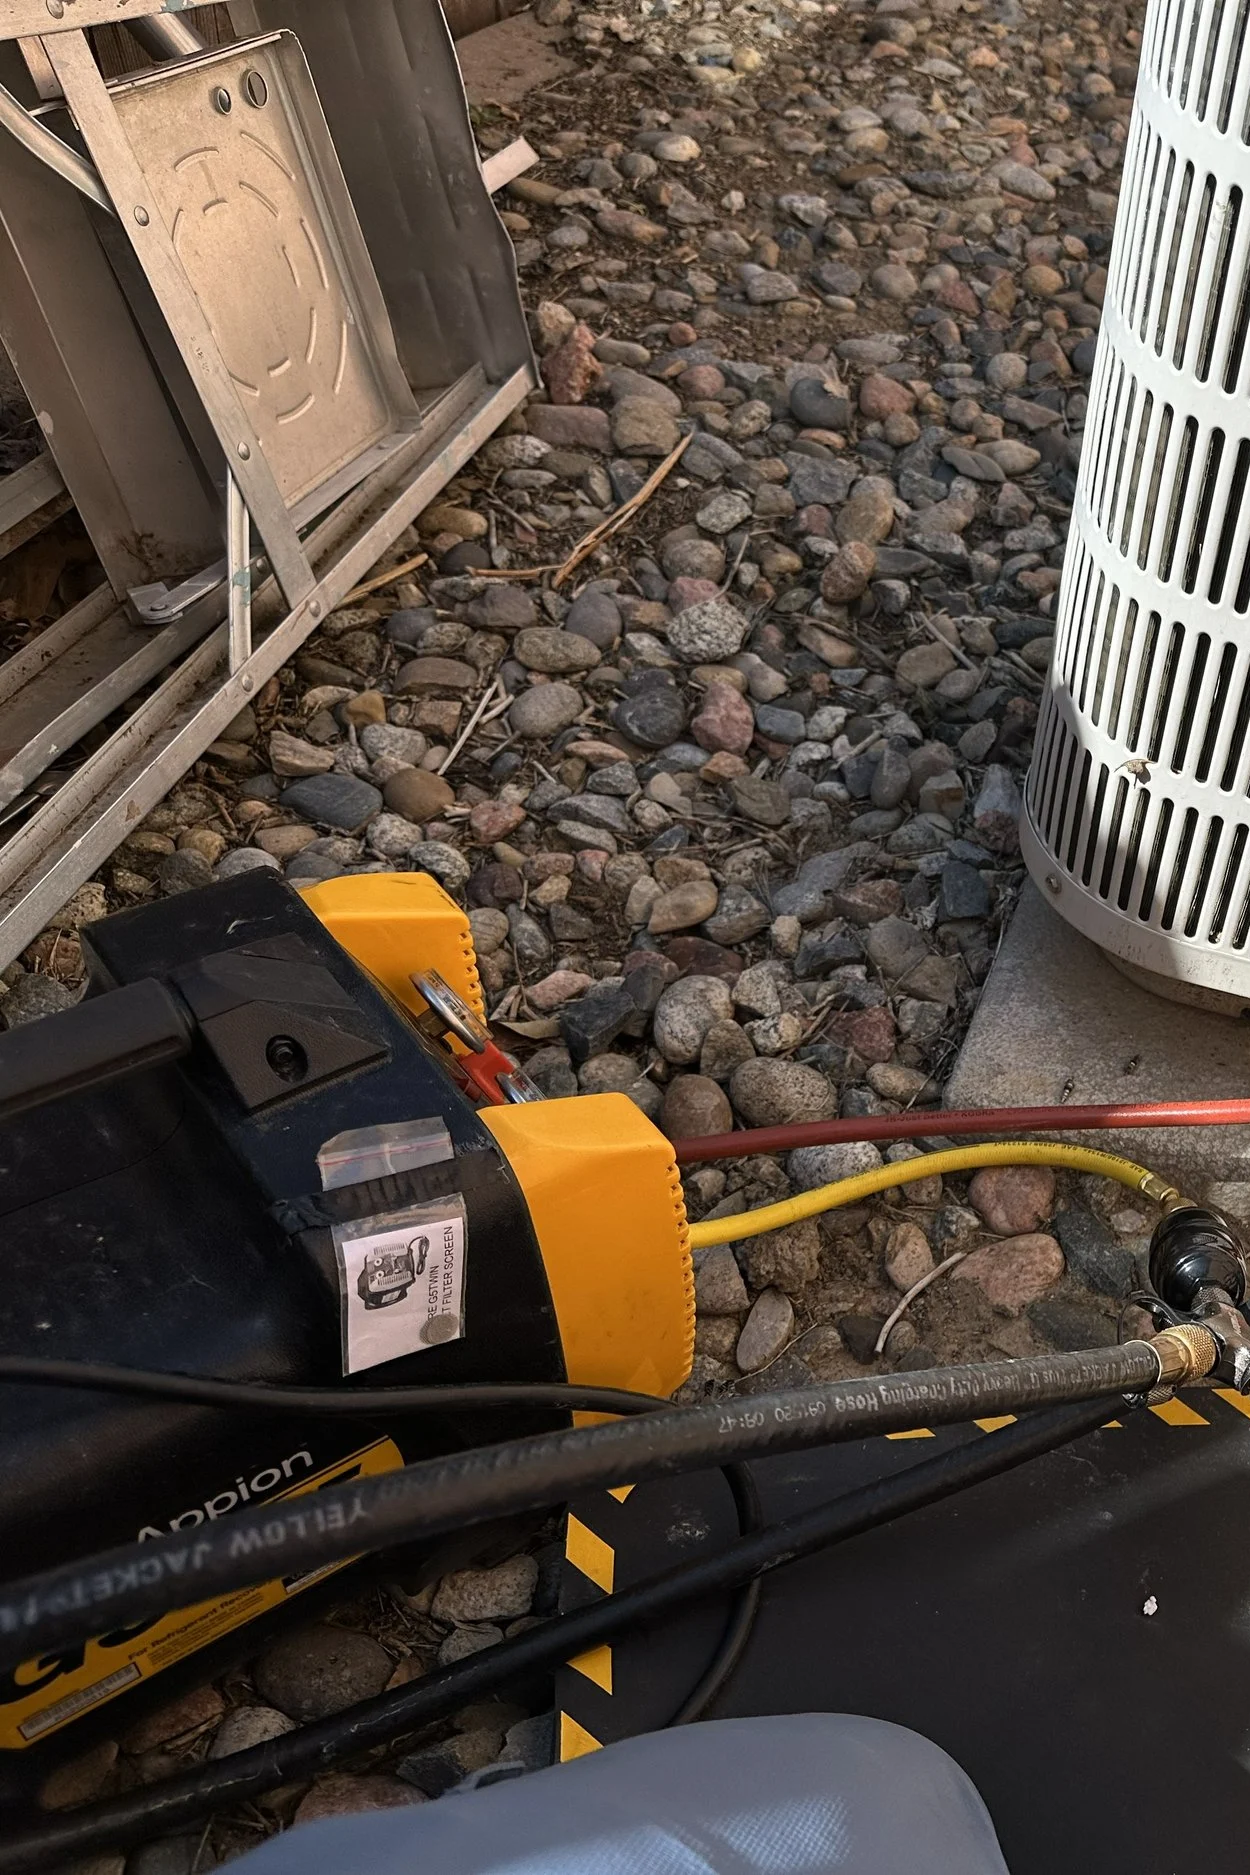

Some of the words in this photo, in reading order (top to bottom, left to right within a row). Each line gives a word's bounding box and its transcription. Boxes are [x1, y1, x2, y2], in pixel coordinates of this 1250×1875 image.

[444, 1226, 454, 1269] SCREEN
[428, 1265, 439, 1304] G5TWIN
[443, 1271, 453, 1303] FILTER
[980, 1367, 1021, 1395] Heavy
[833, 1391, 879, 1414] Hose
[228, 1496, 369, 1558] YELLOW
[151, 1606, 217, 1648] Refrigerant
